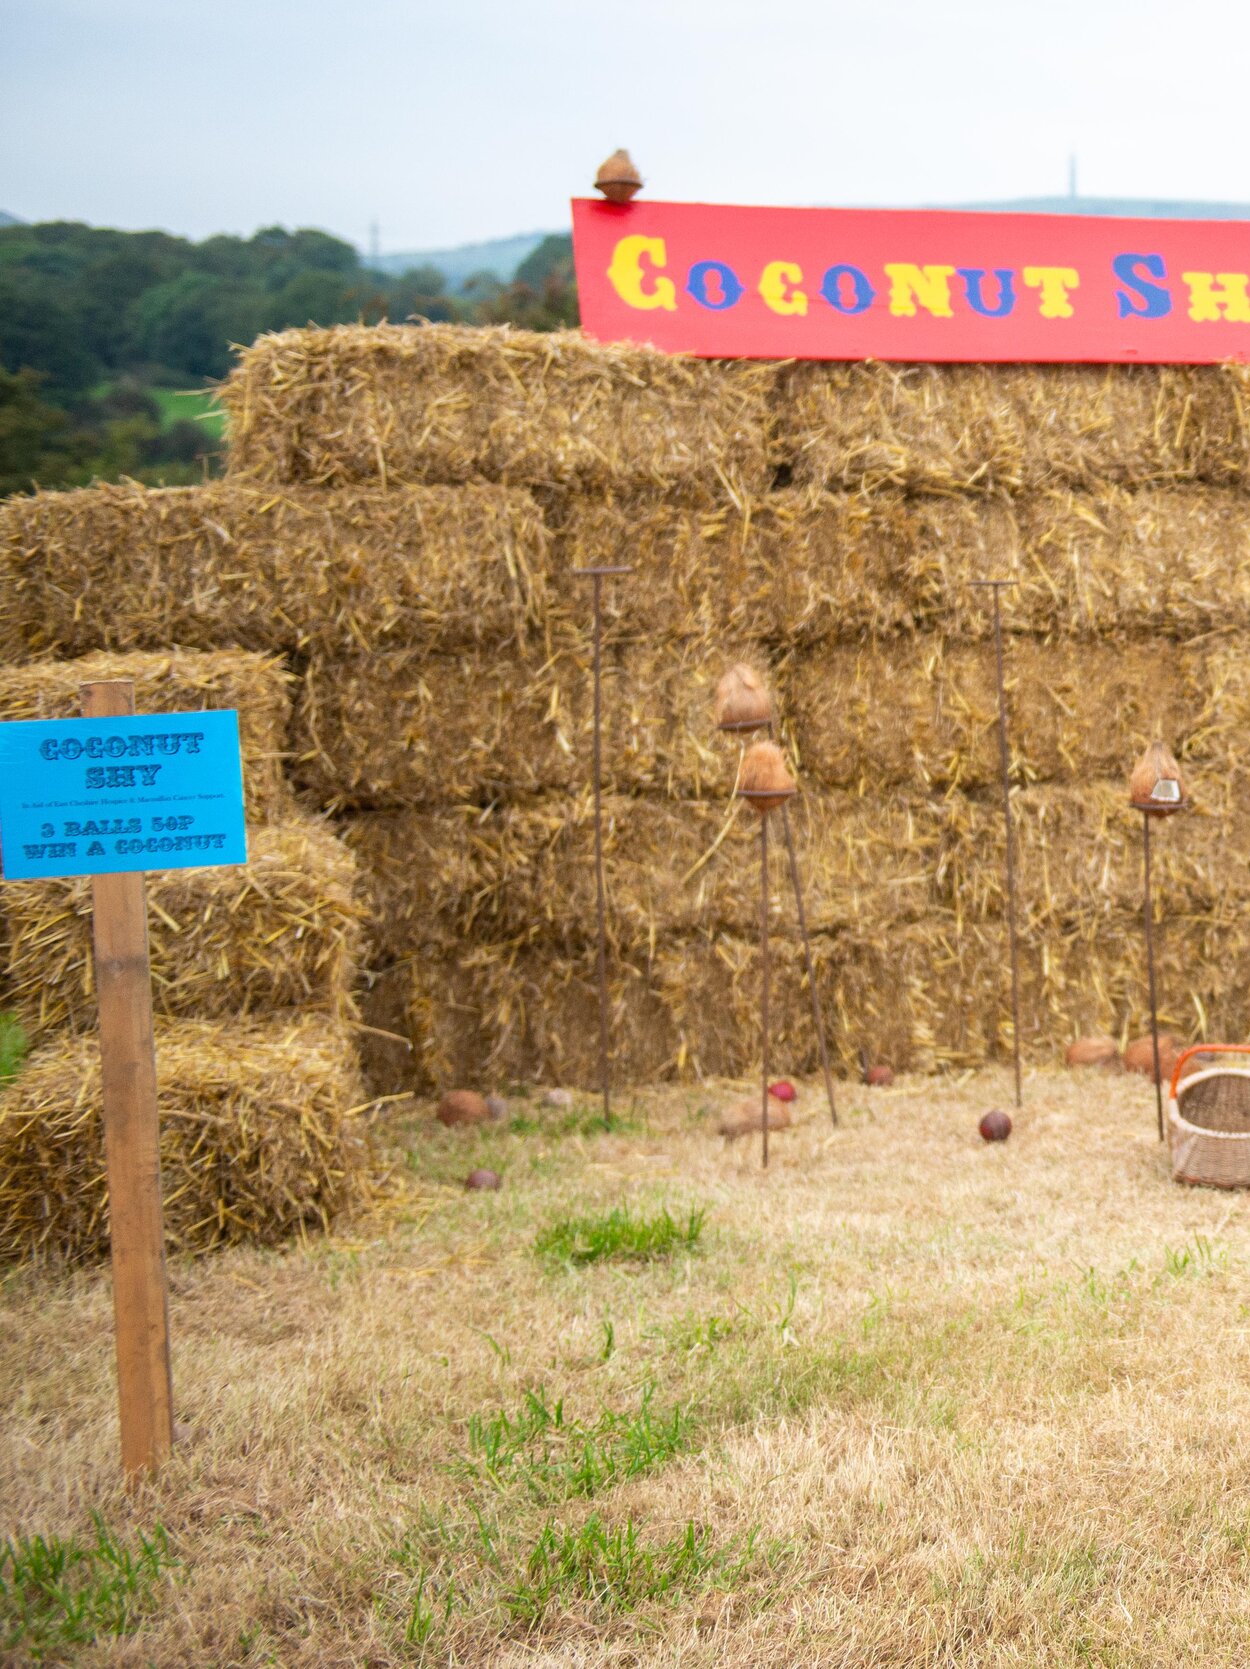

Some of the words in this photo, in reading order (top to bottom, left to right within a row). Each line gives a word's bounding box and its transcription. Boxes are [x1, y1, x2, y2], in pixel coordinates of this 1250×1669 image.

[39, 732, 204, 760] COCONUT
[85, 763, 162, 789] SHY
[40, 822, 55, 838] 3
[64, 817, 142, 837] BALLS
[151, 815, 195, 832] 50P
[22, 841, 77, 859] WIN
[86, 840, 106, 856] A
[115, 834, 227, 854] COCONUT
